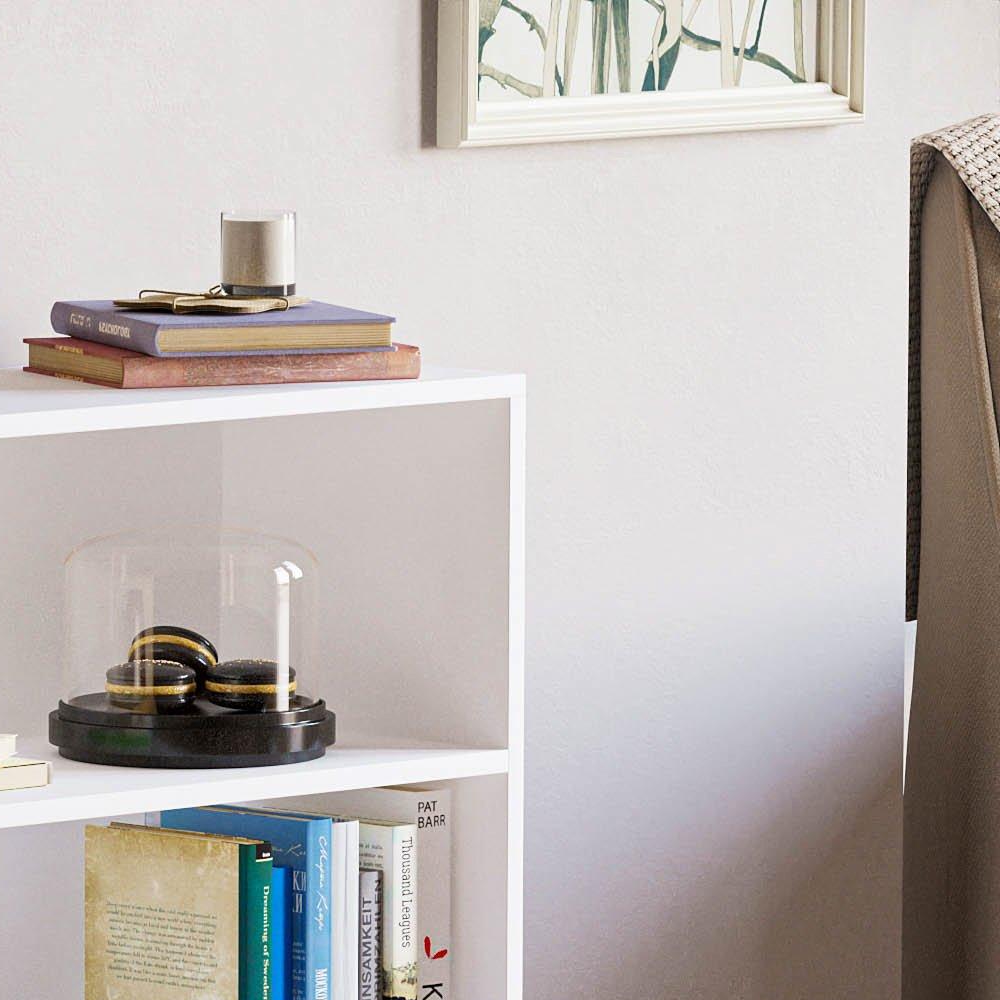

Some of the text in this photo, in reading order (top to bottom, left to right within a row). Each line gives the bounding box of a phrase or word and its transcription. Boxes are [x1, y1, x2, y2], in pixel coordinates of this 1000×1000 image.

[418, 800, 437, 813] PAT
[418, 814, 446, 829] BARR
[399, 836, 413, 948] Thousand Leagues
[262, 885, 270, 942] Dreaming
[263, 945, 270, 956] of
